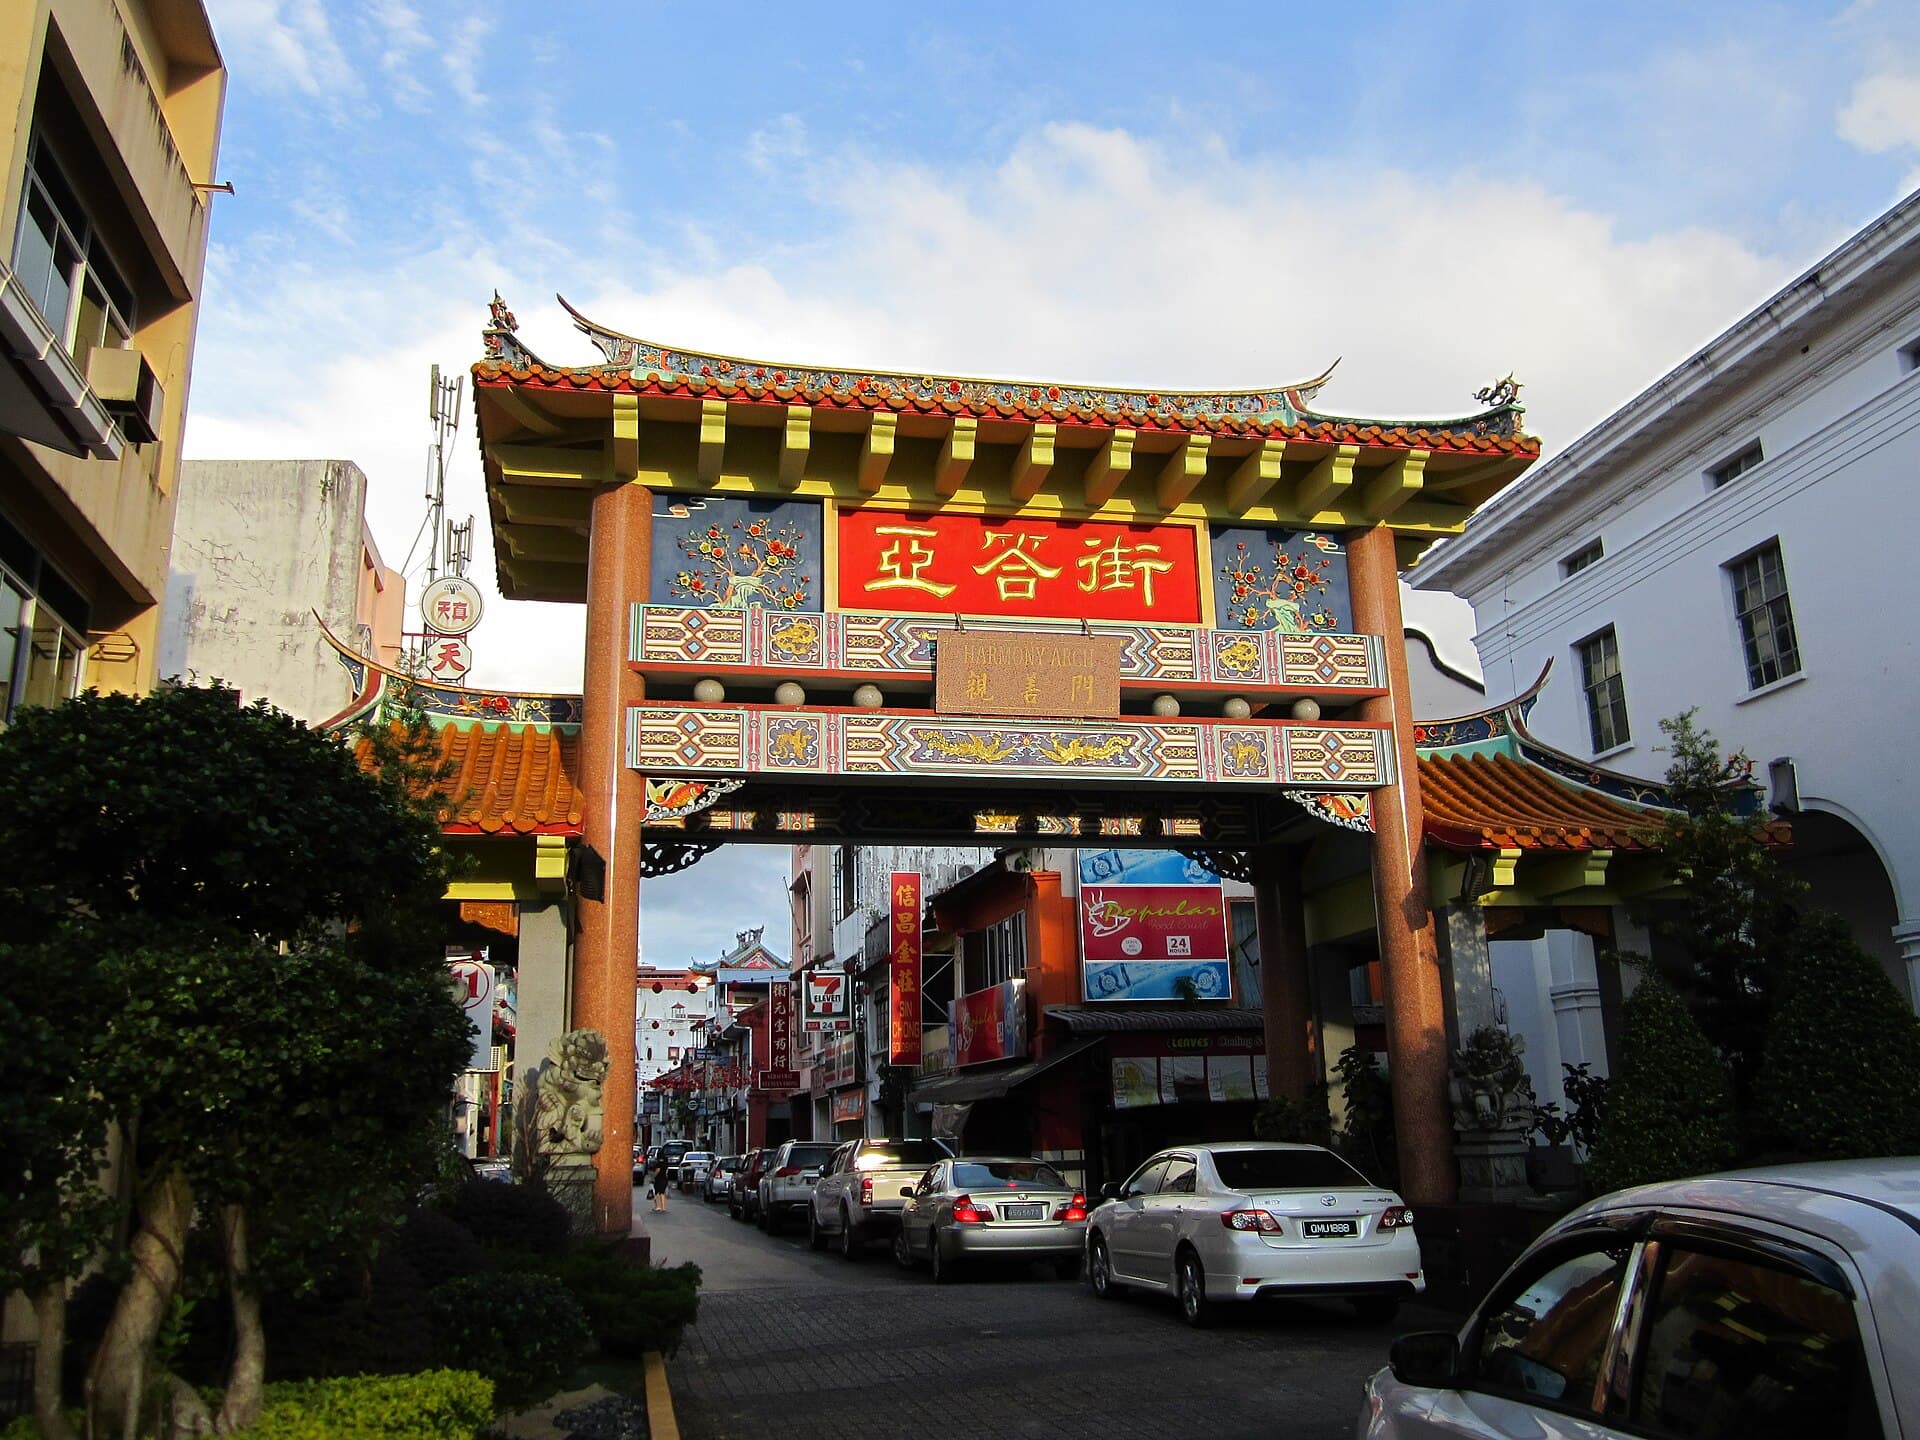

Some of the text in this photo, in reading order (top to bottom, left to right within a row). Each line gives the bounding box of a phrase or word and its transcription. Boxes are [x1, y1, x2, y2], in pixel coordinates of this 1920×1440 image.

[864, 525, 1174, 606] 亞答街
[432, 643, 466, 671] 天
[964, 645, 1095, 667] HARMONY ARCH
[1104, 899, 1221, 922] Popular
[1170, 938, 1187, 949] 24
[813, 976, 841, 1013] 7
[899, 1001, 913, 1017] SIN
[891, 1021, 920, 1038] CHONG
